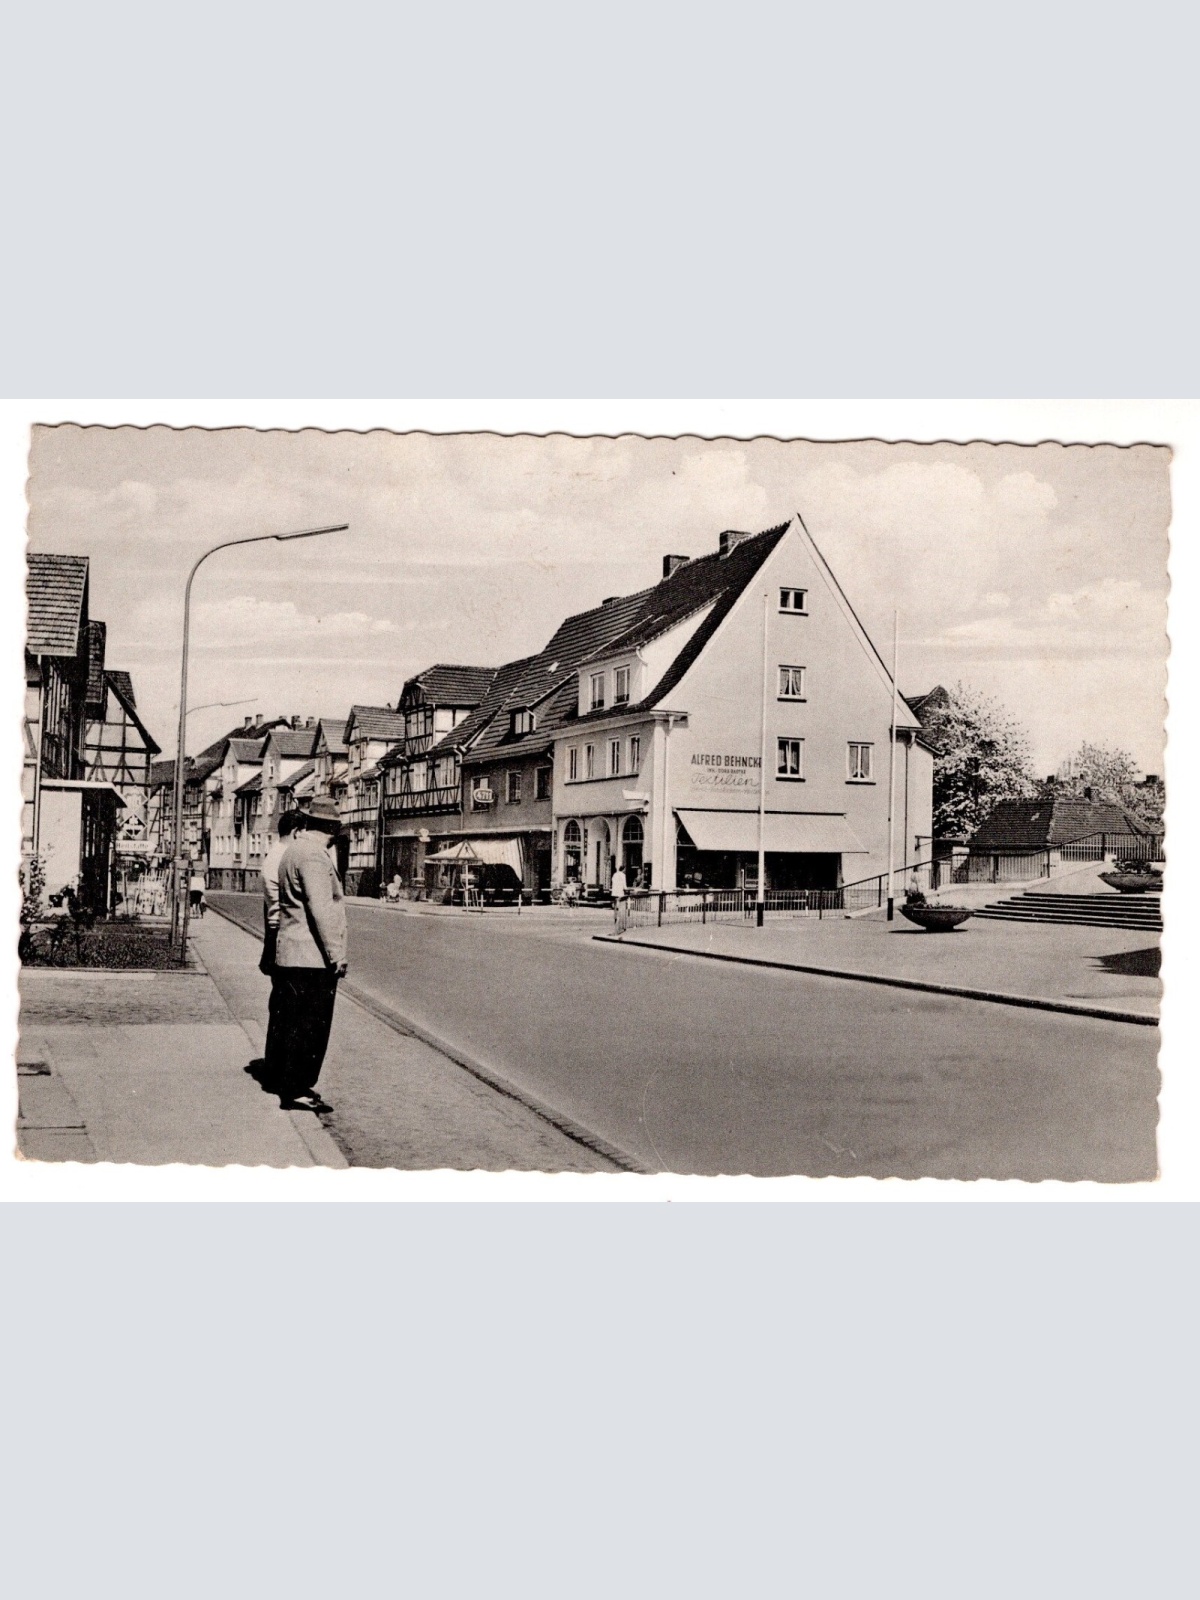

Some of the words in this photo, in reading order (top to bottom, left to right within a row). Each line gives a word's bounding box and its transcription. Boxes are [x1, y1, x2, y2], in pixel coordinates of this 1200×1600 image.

[691, 754, 722, 767] ALFRED
[691, 772, 760, 787] Textilien
[476, 791, 493, 800] 4711
